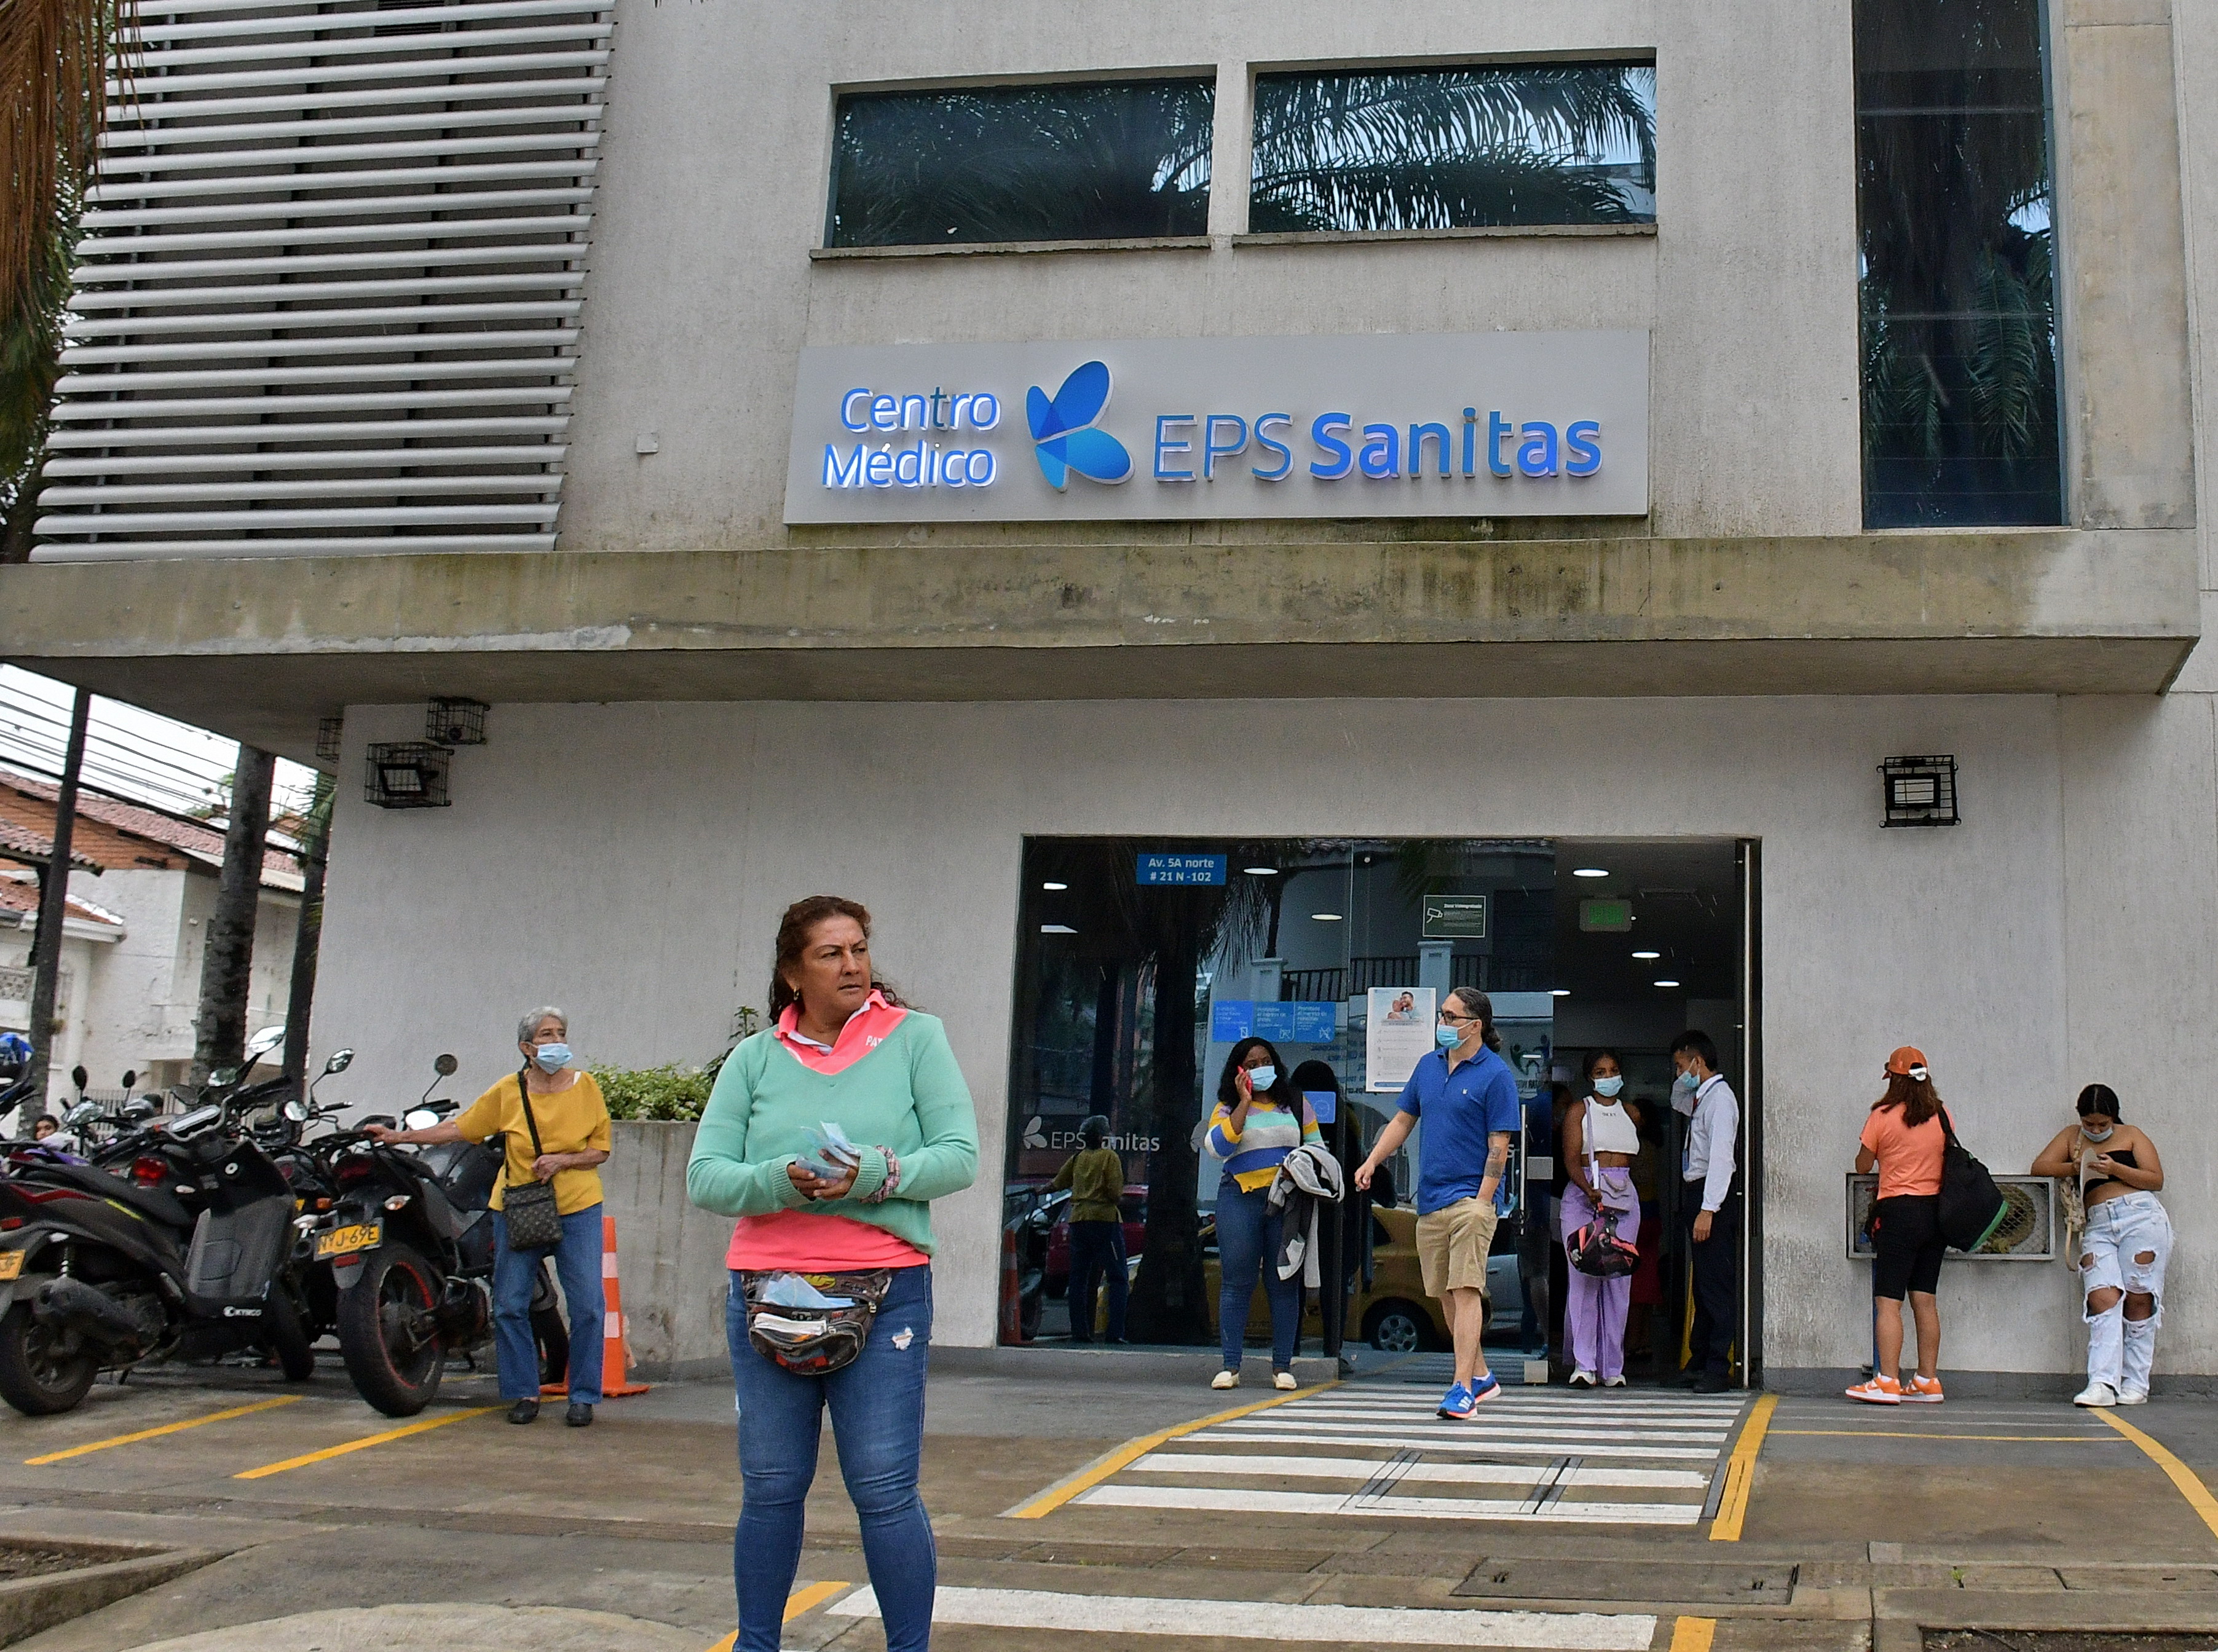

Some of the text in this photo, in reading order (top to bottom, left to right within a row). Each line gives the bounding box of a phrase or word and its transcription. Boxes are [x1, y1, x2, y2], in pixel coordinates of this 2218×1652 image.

[840, 387, 1000, 432] Centro
[1153, 406, 1602, 482] EPS Sanitas
[822, 439, 997, 489] Médico
[1148, 858, 1215, 868] Av. 5A norte
[1159, 871, 1173, 881] 21
[1175, 871, 1184, 881] N
[1051, 1131, 1160, 1152] EPS anitas
